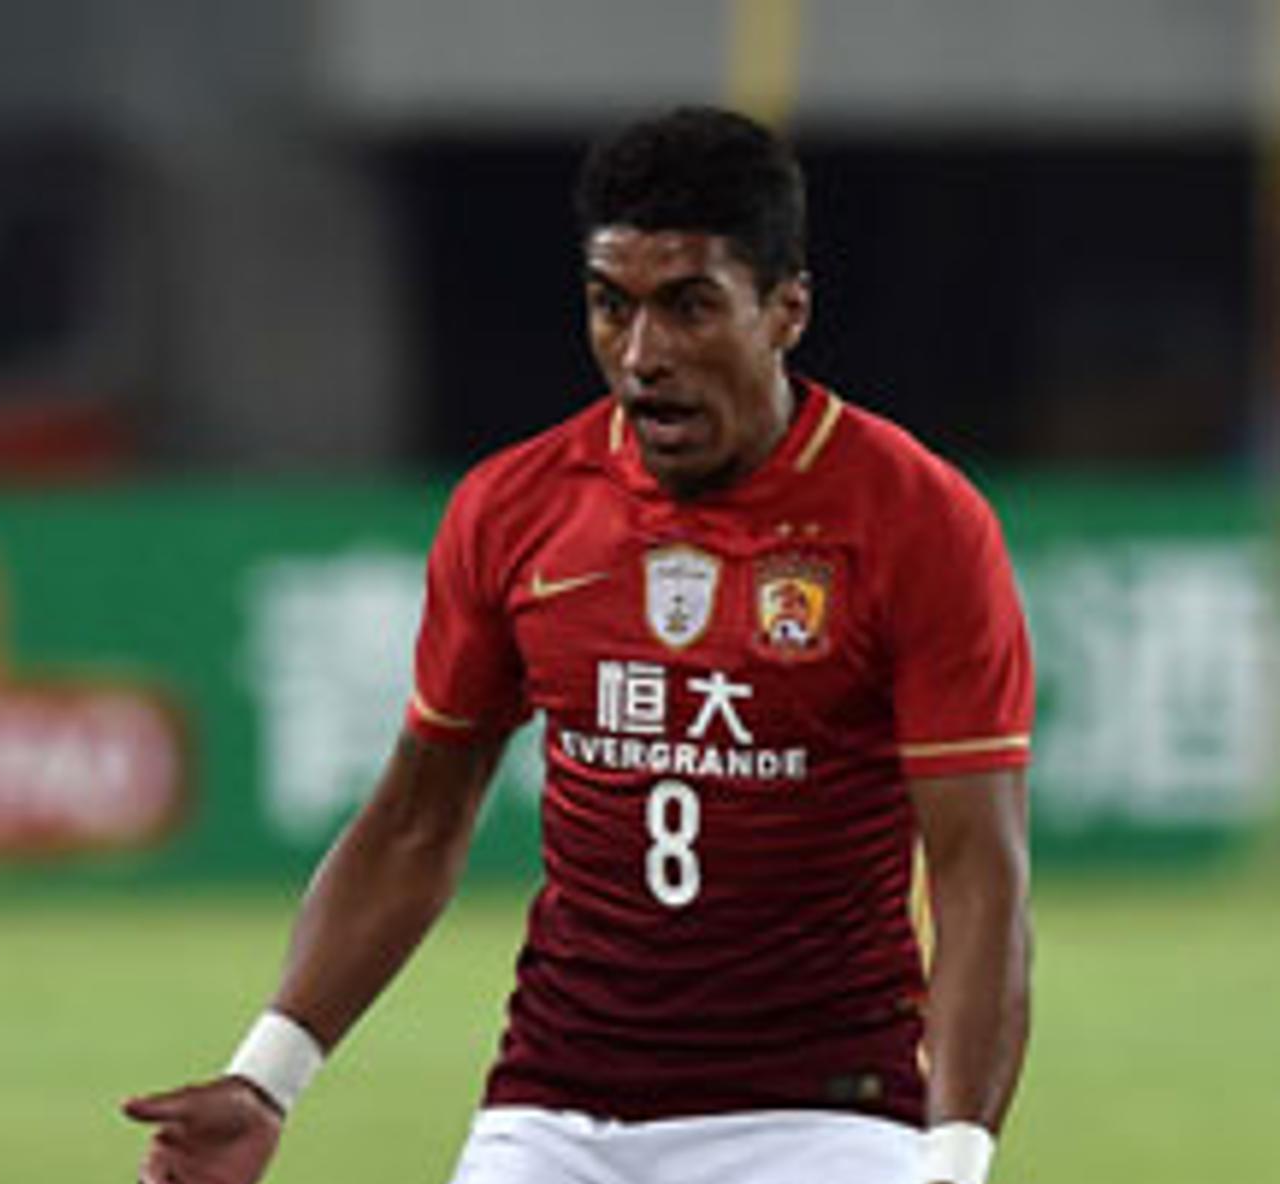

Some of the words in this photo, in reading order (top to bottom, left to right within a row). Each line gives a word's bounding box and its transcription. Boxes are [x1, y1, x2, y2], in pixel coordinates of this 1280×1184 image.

[596, 660, 754, 744] 恒大
[560, 730, 807, 779] EVERGRANDE
[644, 778, 702, 907] 8
